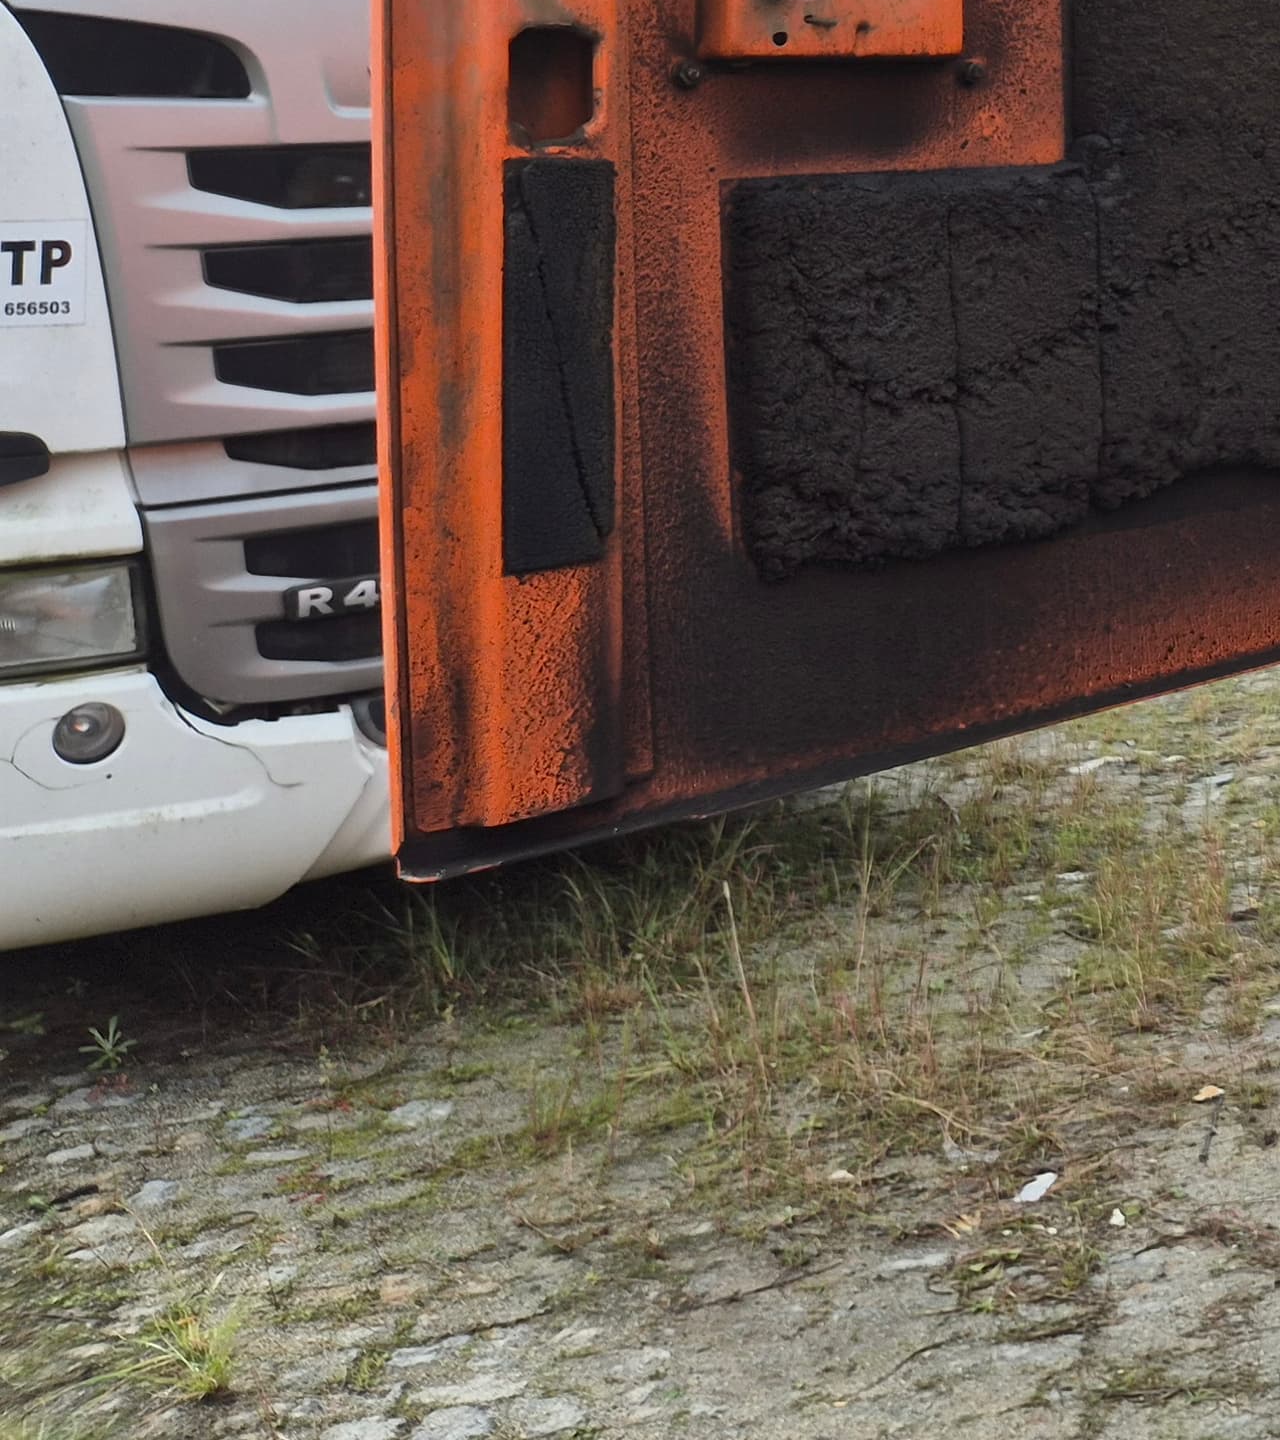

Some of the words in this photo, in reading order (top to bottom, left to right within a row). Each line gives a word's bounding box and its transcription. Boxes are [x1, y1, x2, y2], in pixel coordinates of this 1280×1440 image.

[0, 240, 72, 286] TP
[4, 301, 71, 316] 656503
[298, 586, 334, 618] R
